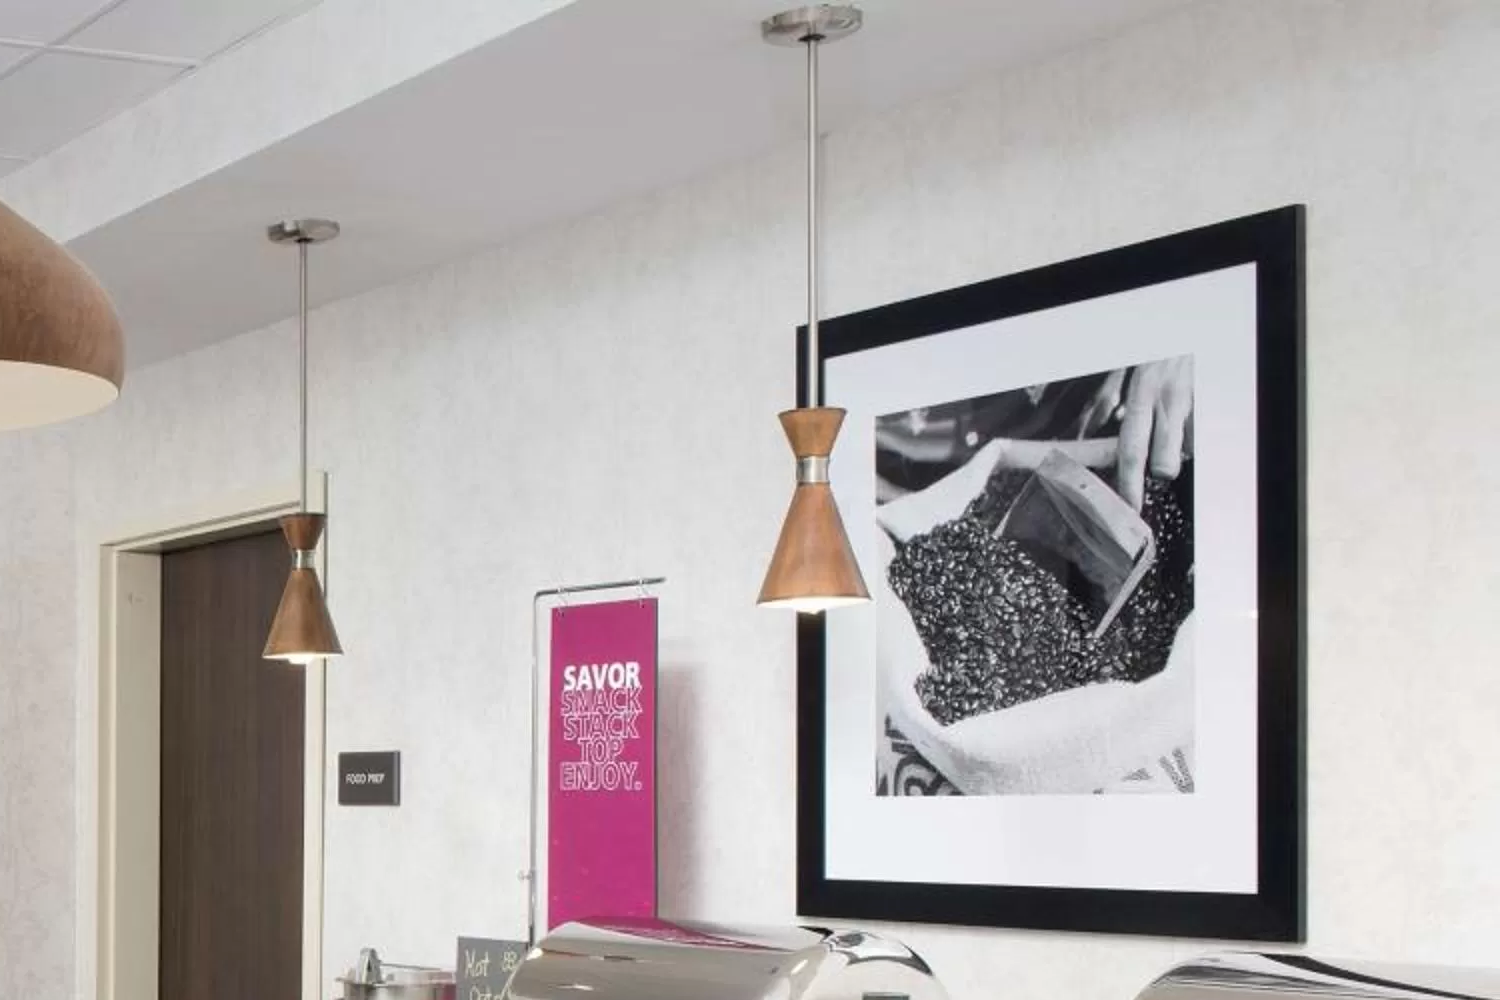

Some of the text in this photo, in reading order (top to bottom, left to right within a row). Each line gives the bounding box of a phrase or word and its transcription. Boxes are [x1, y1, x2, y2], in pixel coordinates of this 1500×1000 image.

[563, 661, 640, 691] SAVOR
[561, 686, 643, 716] SNACK
[563, 711, 641, 741] STACK
[577, 736, 624, 764] TOP
[345, 773, 367, 785] FOOD
[560, 761, 643, 791] ENJOY.
